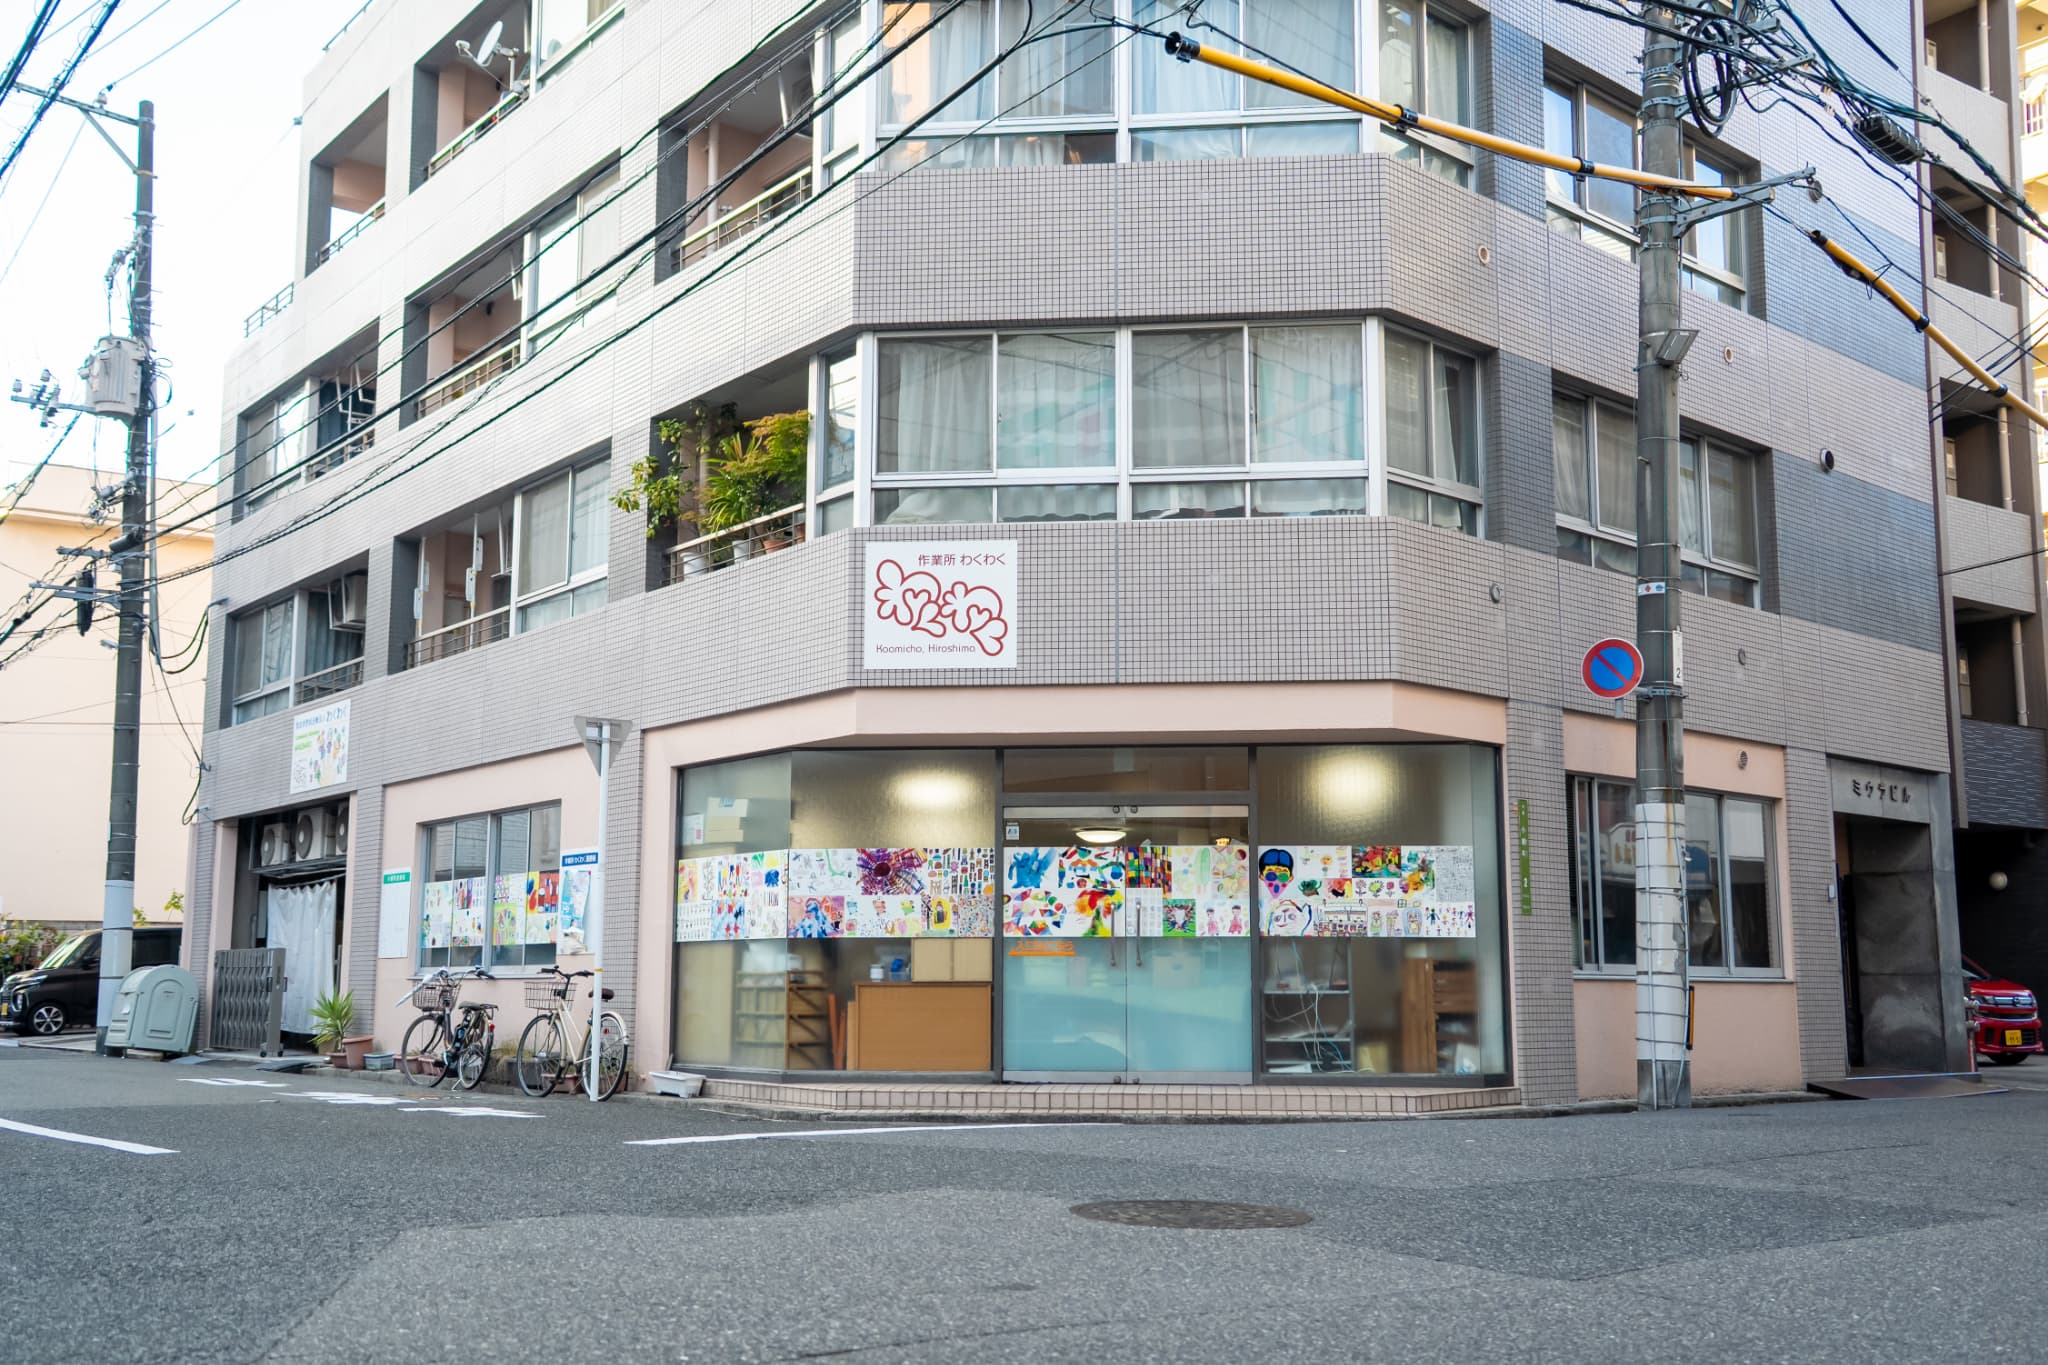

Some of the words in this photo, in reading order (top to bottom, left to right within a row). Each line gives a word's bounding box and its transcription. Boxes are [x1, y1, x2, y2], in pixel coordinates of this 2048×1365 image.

[918, 554, 956, 566] 作業所
[960, 553, 1006, 566] わくわく
[1852, 779, 1912, 804] ミウラビル
